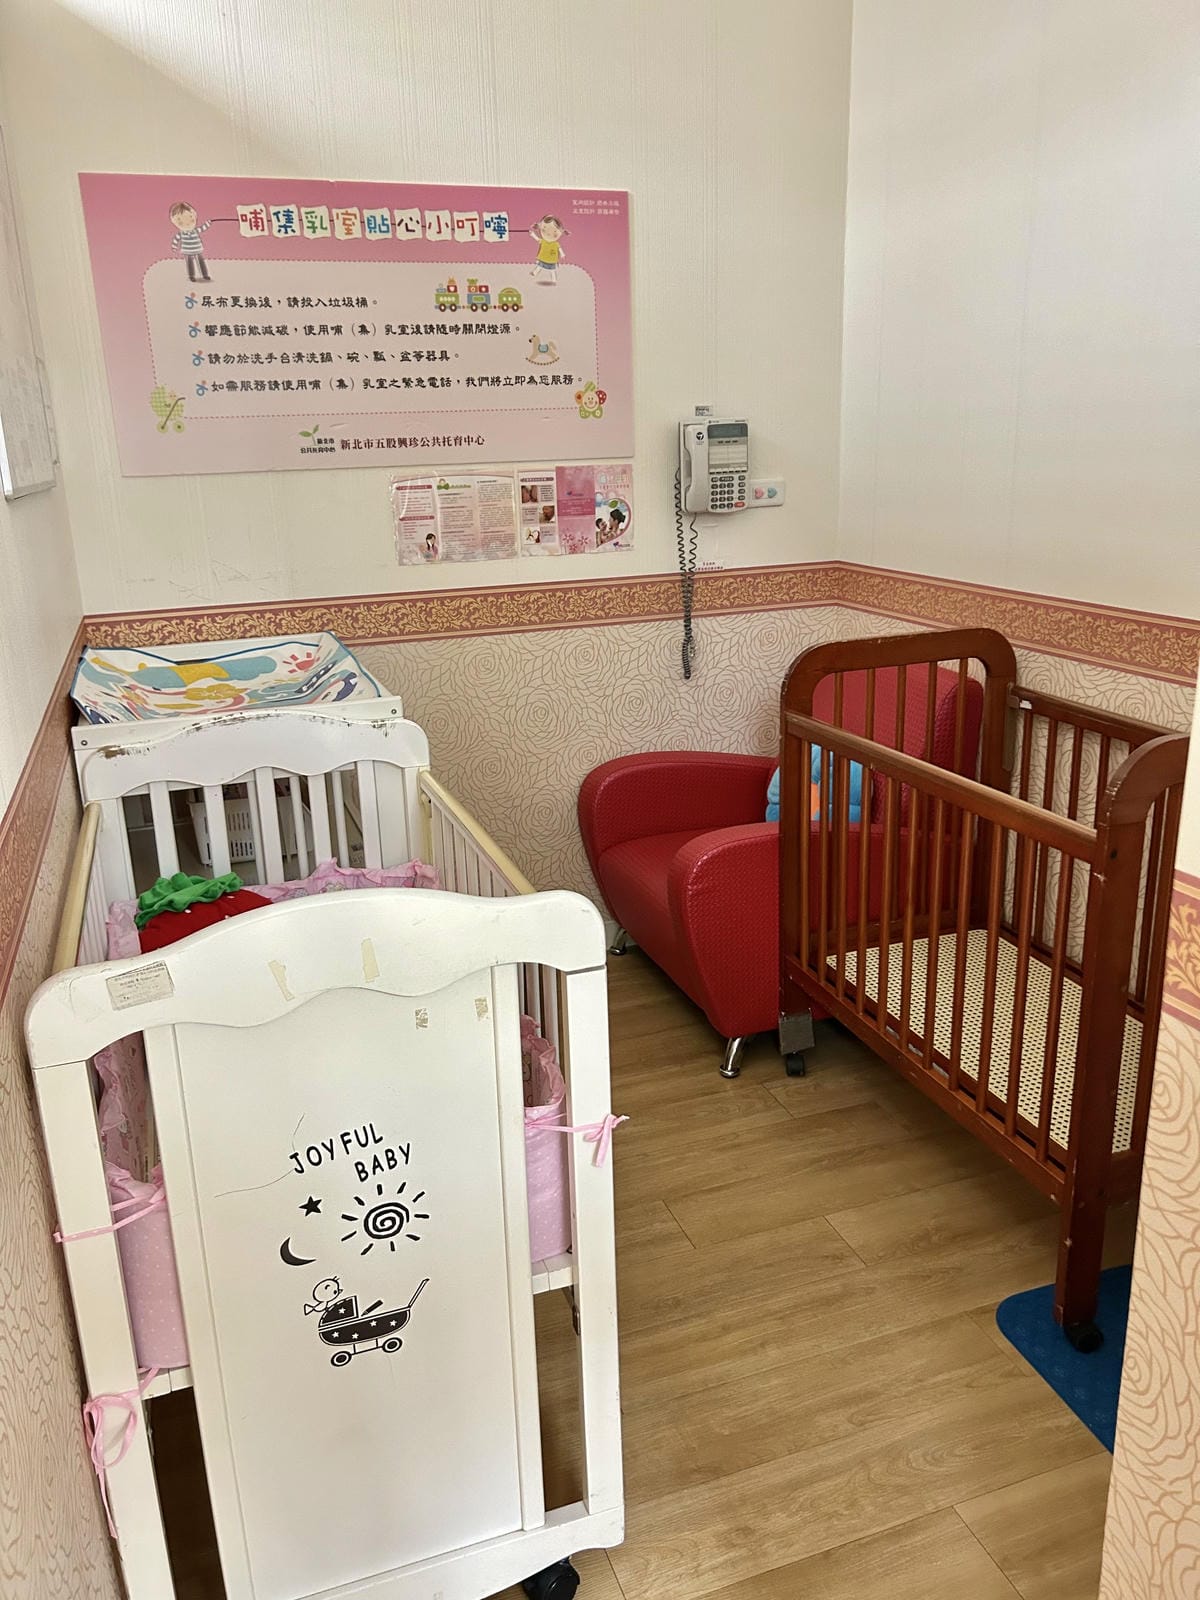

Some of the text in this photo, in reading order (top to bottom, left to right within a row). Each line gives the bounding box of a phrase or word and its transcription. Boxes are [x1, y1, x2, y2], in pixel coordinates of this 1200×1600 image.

[241, 209, 508, 239] 哺集乳室貼心小叮嚀
[340, 434, 486, 451] 新北市五股興珍公共托育中心
[289, 1123, 384, 1174] JOYFUL
[354, 1142, 411, 1183] BABY
